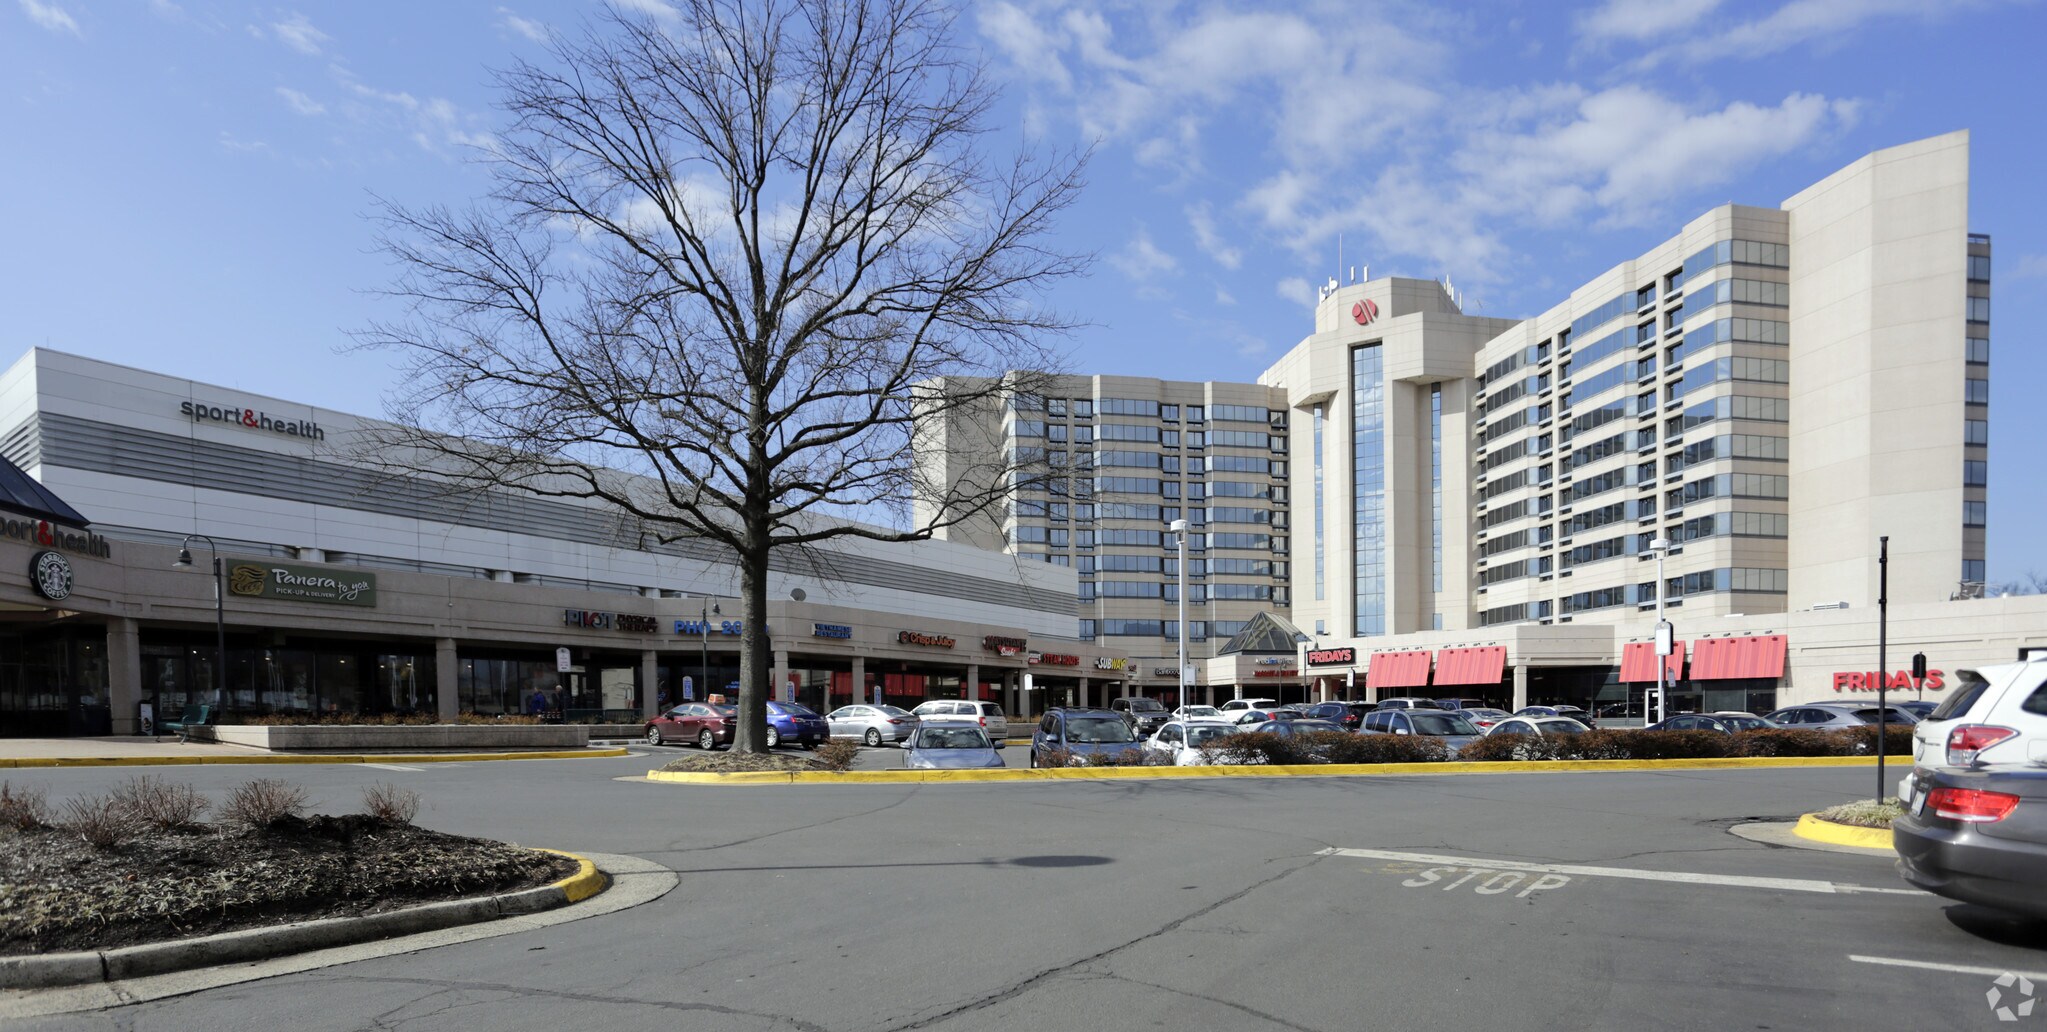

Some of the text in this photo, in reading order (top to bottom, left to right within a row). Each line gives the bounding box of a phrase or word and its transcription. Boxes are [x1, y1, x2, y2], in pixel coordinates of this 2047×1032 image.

[180, 401, 325, 441] sport&health
[40, 554, 71, 577] STARBUCKS
[272, 568, 336, 588] Panera
[338, 581, 348, 594] to
[43, 582, 69, 598] COFFEE
[276, 587, 304, 596] PICK-UP
[565, 609, 614, 629] PIVOT
[616, 614, 658, 625] PHYSICAL
[617, 623, 658, 633] THERAPY
[674, 620, 711, 635] PHO
[815, 623, 852, 633] VIETNAMESE
[815, 630, 852, 639] RESTAURANT
[910, 632, 930, 646] Crisp
[937, 636, 957, 648] Juicy
[1062, 655, 1079, 666] HOUSE
[1098, 657, 1128, 670] SUBWAY
[1308, 649, 1352, 664] FRIDAYS
[1833, 669, 1945, 690] FRIDAYS
[1401, 867, 1571, 898] STOP
